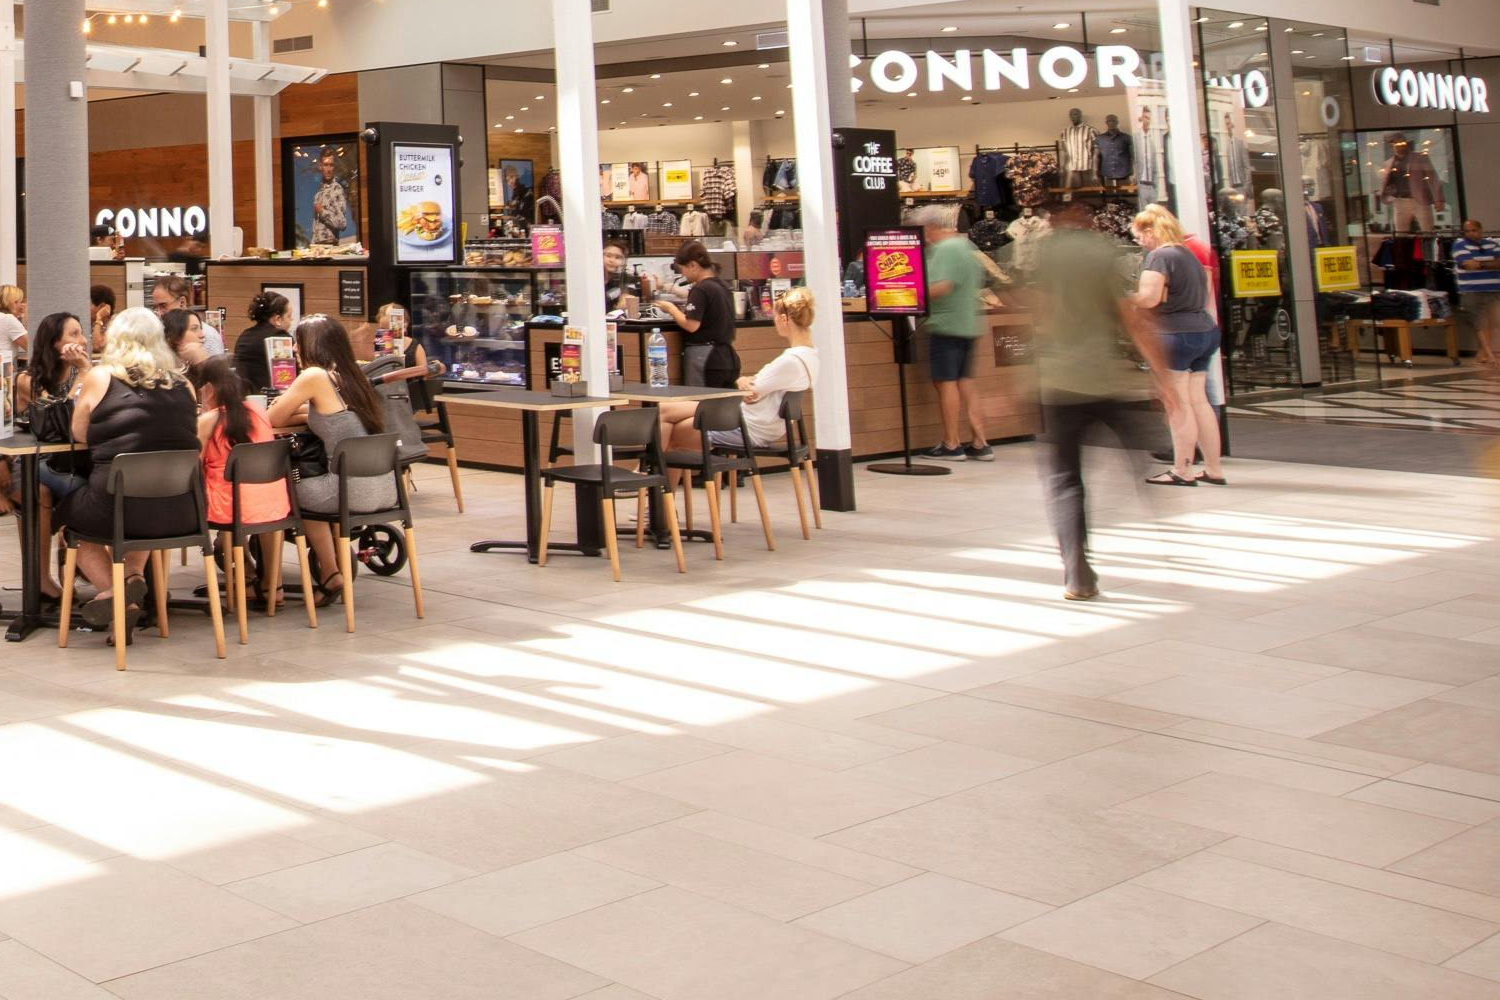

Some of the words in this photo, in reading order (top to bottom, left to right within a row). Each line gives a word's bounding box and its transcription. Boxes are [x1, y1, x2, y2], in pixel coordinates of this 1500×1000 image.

[850, 45, 1140, 93] ONNOR
[1381, 67, 1490, 112] CONNOR
[862, 142, 881, 155] THE
[399, 154, 436, 162] BUTTERMILK
[853, 156, 893, 174] COFFEE
[399, 163, 427, 171] CHICKEN
[399, 185, 425, 193] BURGER
[863, 176, 886, 190] CLUB
[95, 206, 206, 238] CONNO
[1240, 262, 1256, 279] FREE
[1323, 257, 1337, 273] FREE
